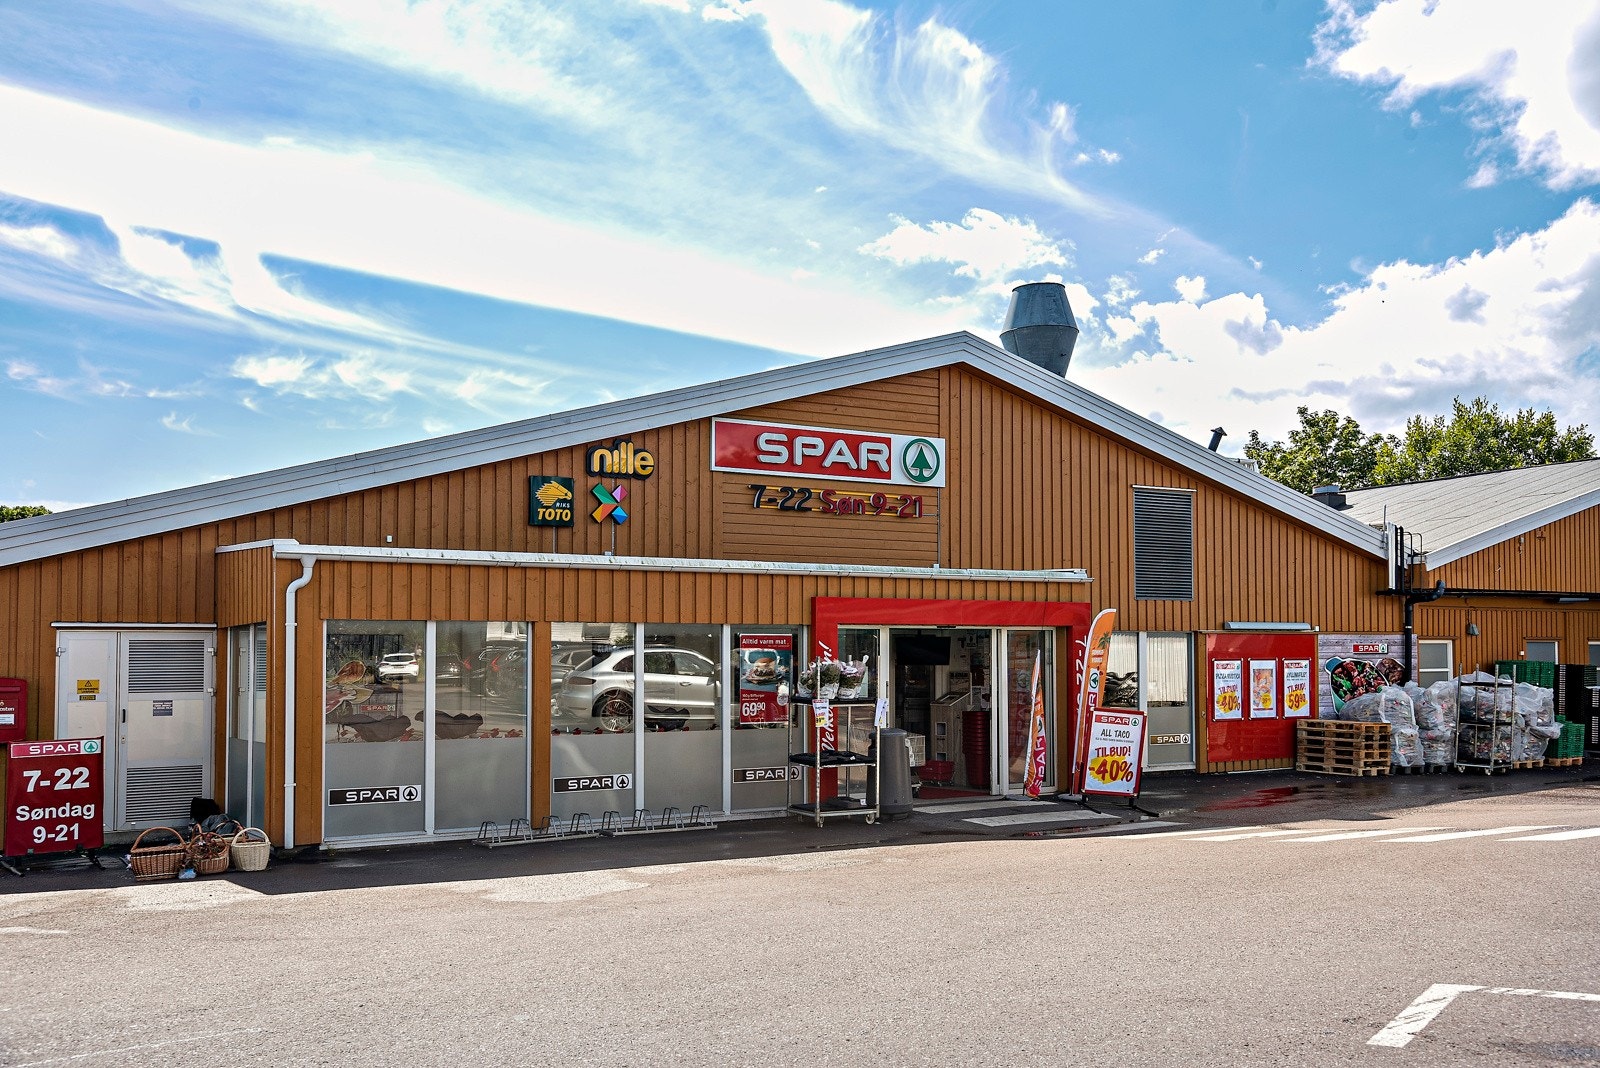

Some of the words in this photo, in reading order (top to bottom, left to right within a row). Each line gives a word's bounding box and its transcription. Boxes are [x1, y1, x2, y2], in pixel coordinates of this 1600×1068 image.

[591, 441, 655, 476] nille
[757, 432, 890, 473] SPAR
[749, 484, 812, 512] 7-22
[819, 488, 866, 516] Søn
[870, 492, 923, 518] 9-21
[537, 508, 571, 522] TOTO
[1216, 695, 1240, 712] -40%
[1101, 716, 1130, 725] SPAR
[1100, 728, 1112, 737] ALL
[1114, 730, 1131, 738] TACO
[29, 743, 79, 755] SPAR
[1095, 746, 1131, 757] TILBUD!
[745, 767, 784, 780] SPAR
[1088, 759, 1134, 783] -40%
[23, 767, 90, 793] 7-22
[568, 778, 612, 790] SPAR
[346, 789, 398, 802] SPAR
[16, 802, 95, 822] Søndag
[33, 822, 79, 843] 9-21
